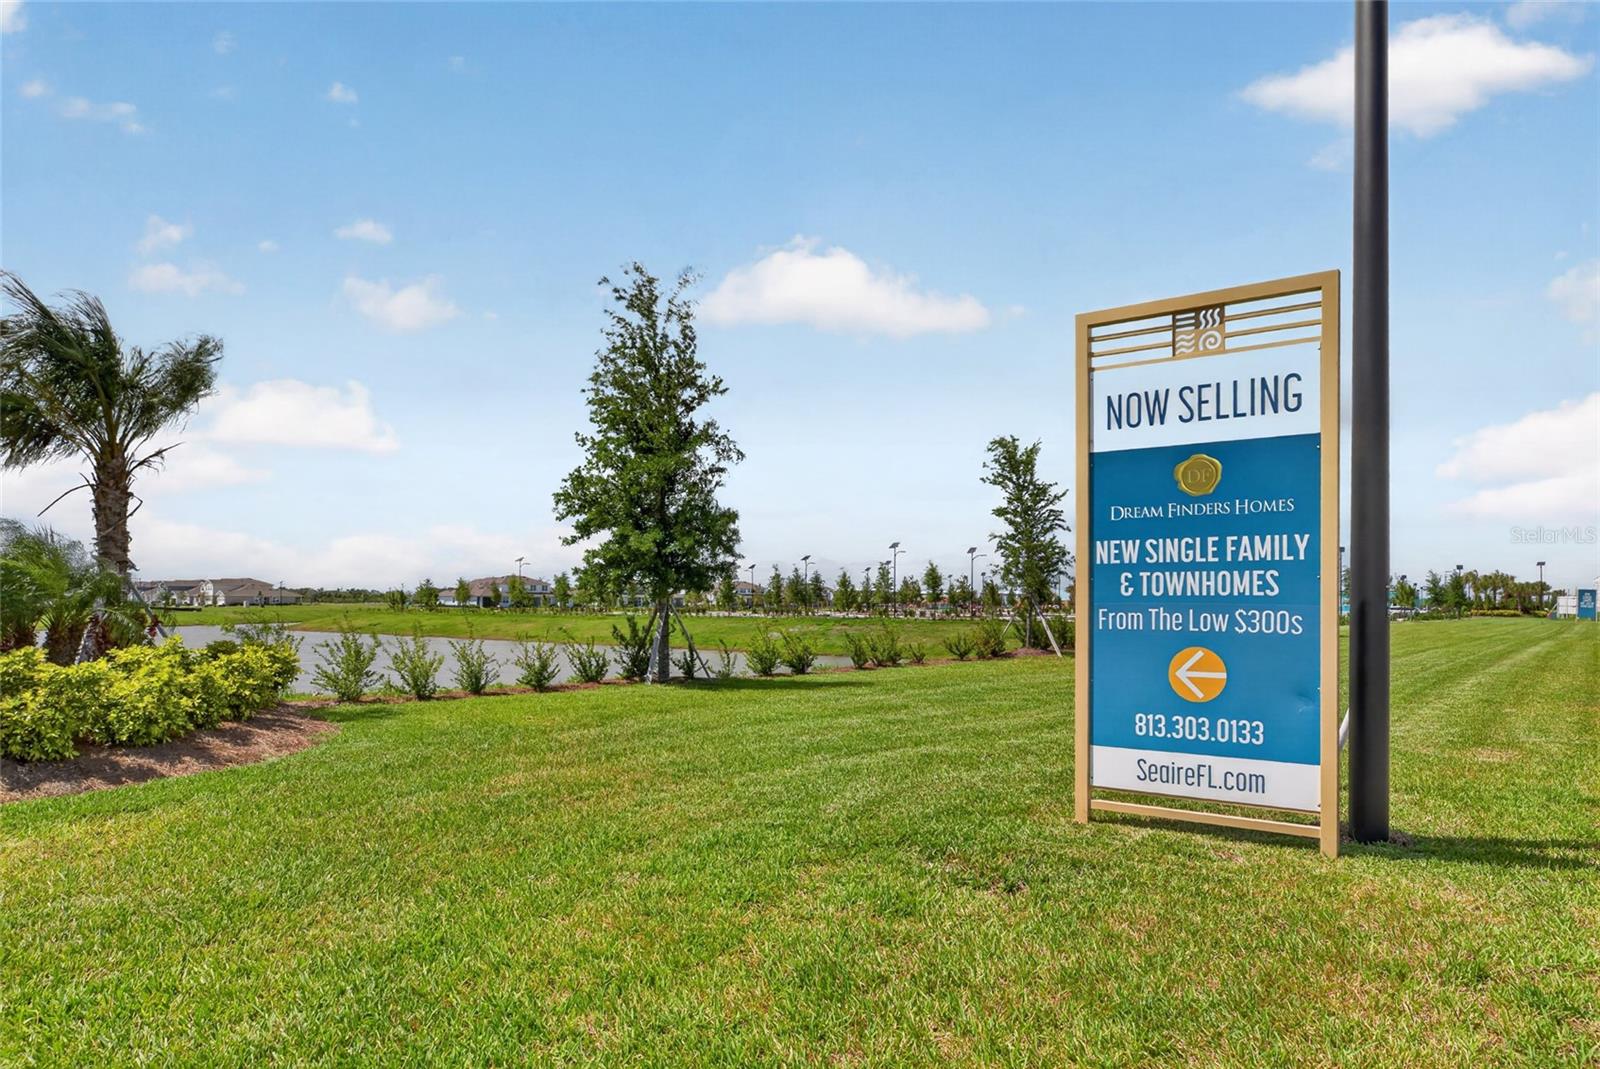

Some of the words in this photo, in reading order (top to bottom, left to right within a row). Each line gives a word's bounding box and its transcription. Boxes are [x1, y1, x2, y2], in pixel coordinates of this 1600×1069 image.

[1107, 388, 1169, 430] NOW
[1178, 372, 1302, 423] SELLING
[1110, 504, 1163, 521] DREAM
[1168, 501, 1230, 519] FINDERS
[1235, 498, 1295, 515] HOMES
[1096, 539, 1140, 564] NEW
[1145, 536, 1219, 563] SINGLE
[1226, 534, 1310, 561] FAMILY
[1120, 573, 1134, 597] &
[1139, 569, 1280, 597] TOWNHOMES
[1098, 608, 1143, 630] From
[1148, 607, 1182, 631] The
[1189, 609, 1229, 632] Low
[1234, 609, 1303, 635] $300s
[1135, 713, 1264, 745] 813.303.0133
[1136, 758, 1266, 794] SeaireFL.com
